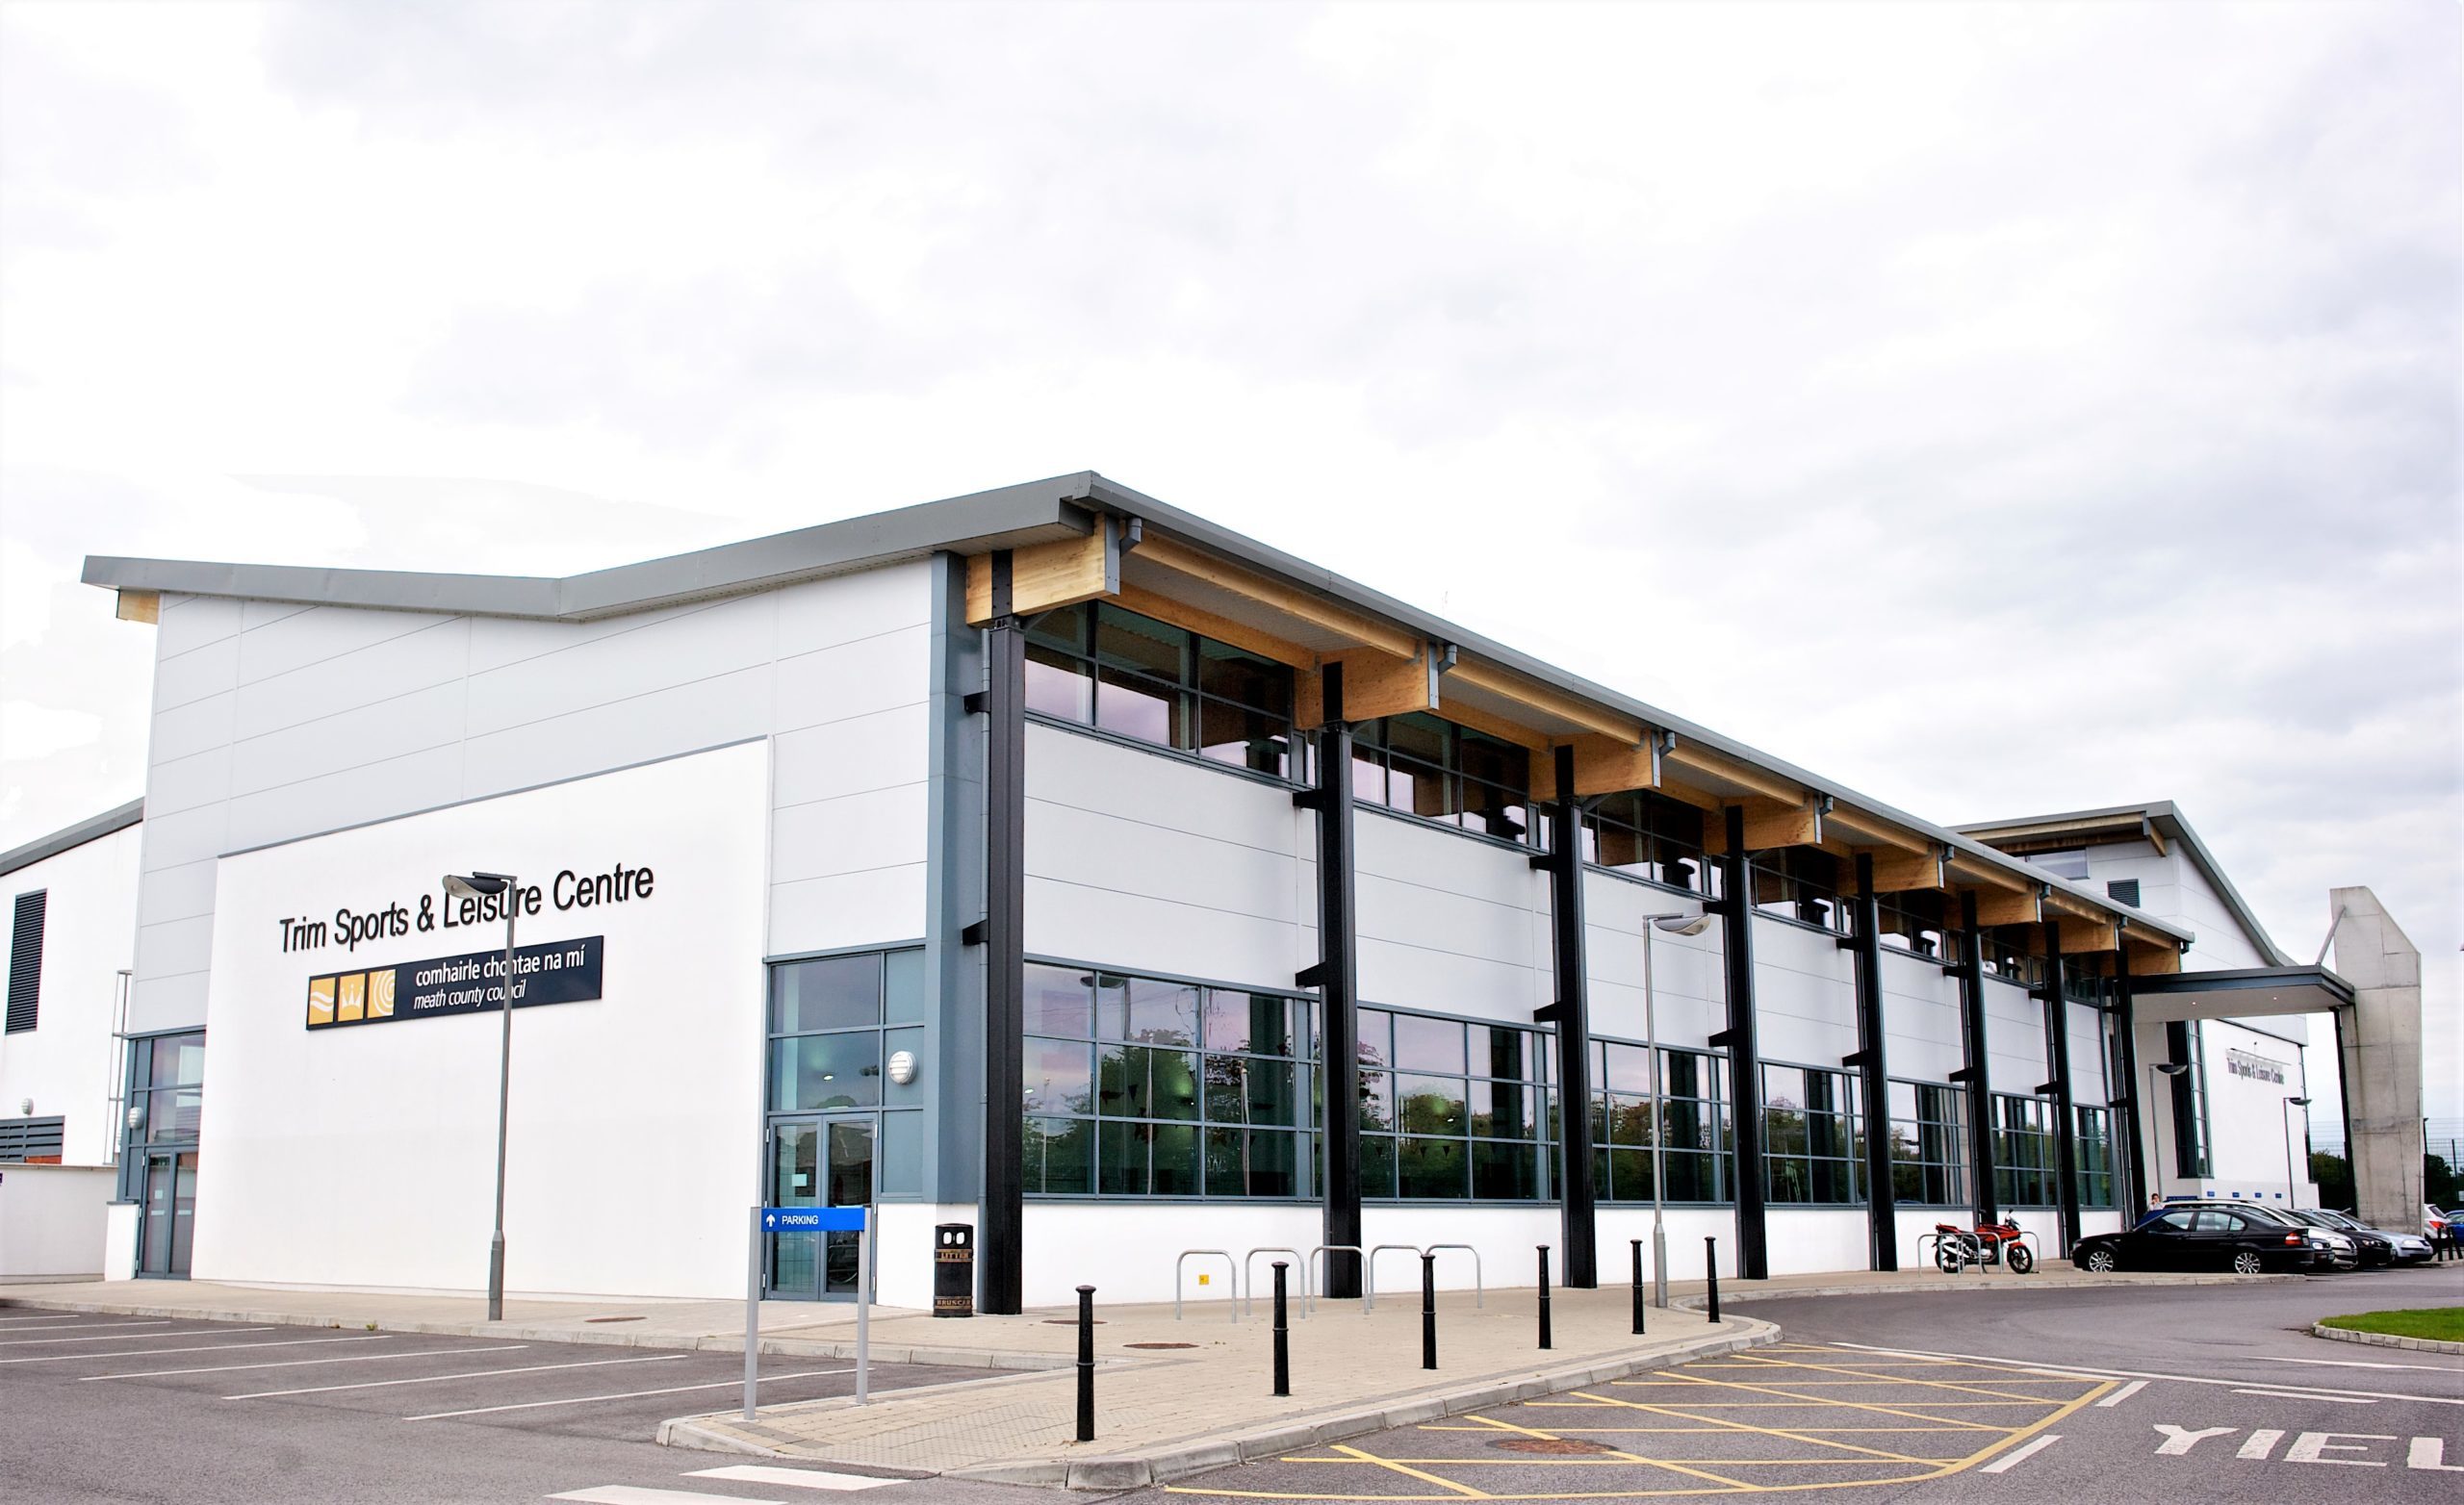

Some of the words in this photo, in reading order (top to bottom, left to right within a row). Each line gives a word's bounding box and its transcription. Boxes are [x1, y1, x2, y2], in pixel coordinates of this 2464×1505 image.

[279, 916, 326, 954] Trim
[334, 902, 409, 953] Sports
[417, 894, 435, 932] &
[553, 862, 654, 911] Centre
[415, 957, 481, 987] comhairle
[544, 953, 562, 971] na
[566, 944, 586, 968] mí
[413, 987, 447, 1010] meath
[448, 985, 485, 1008] county
[782, 1214, 818, 1225] PARKING
